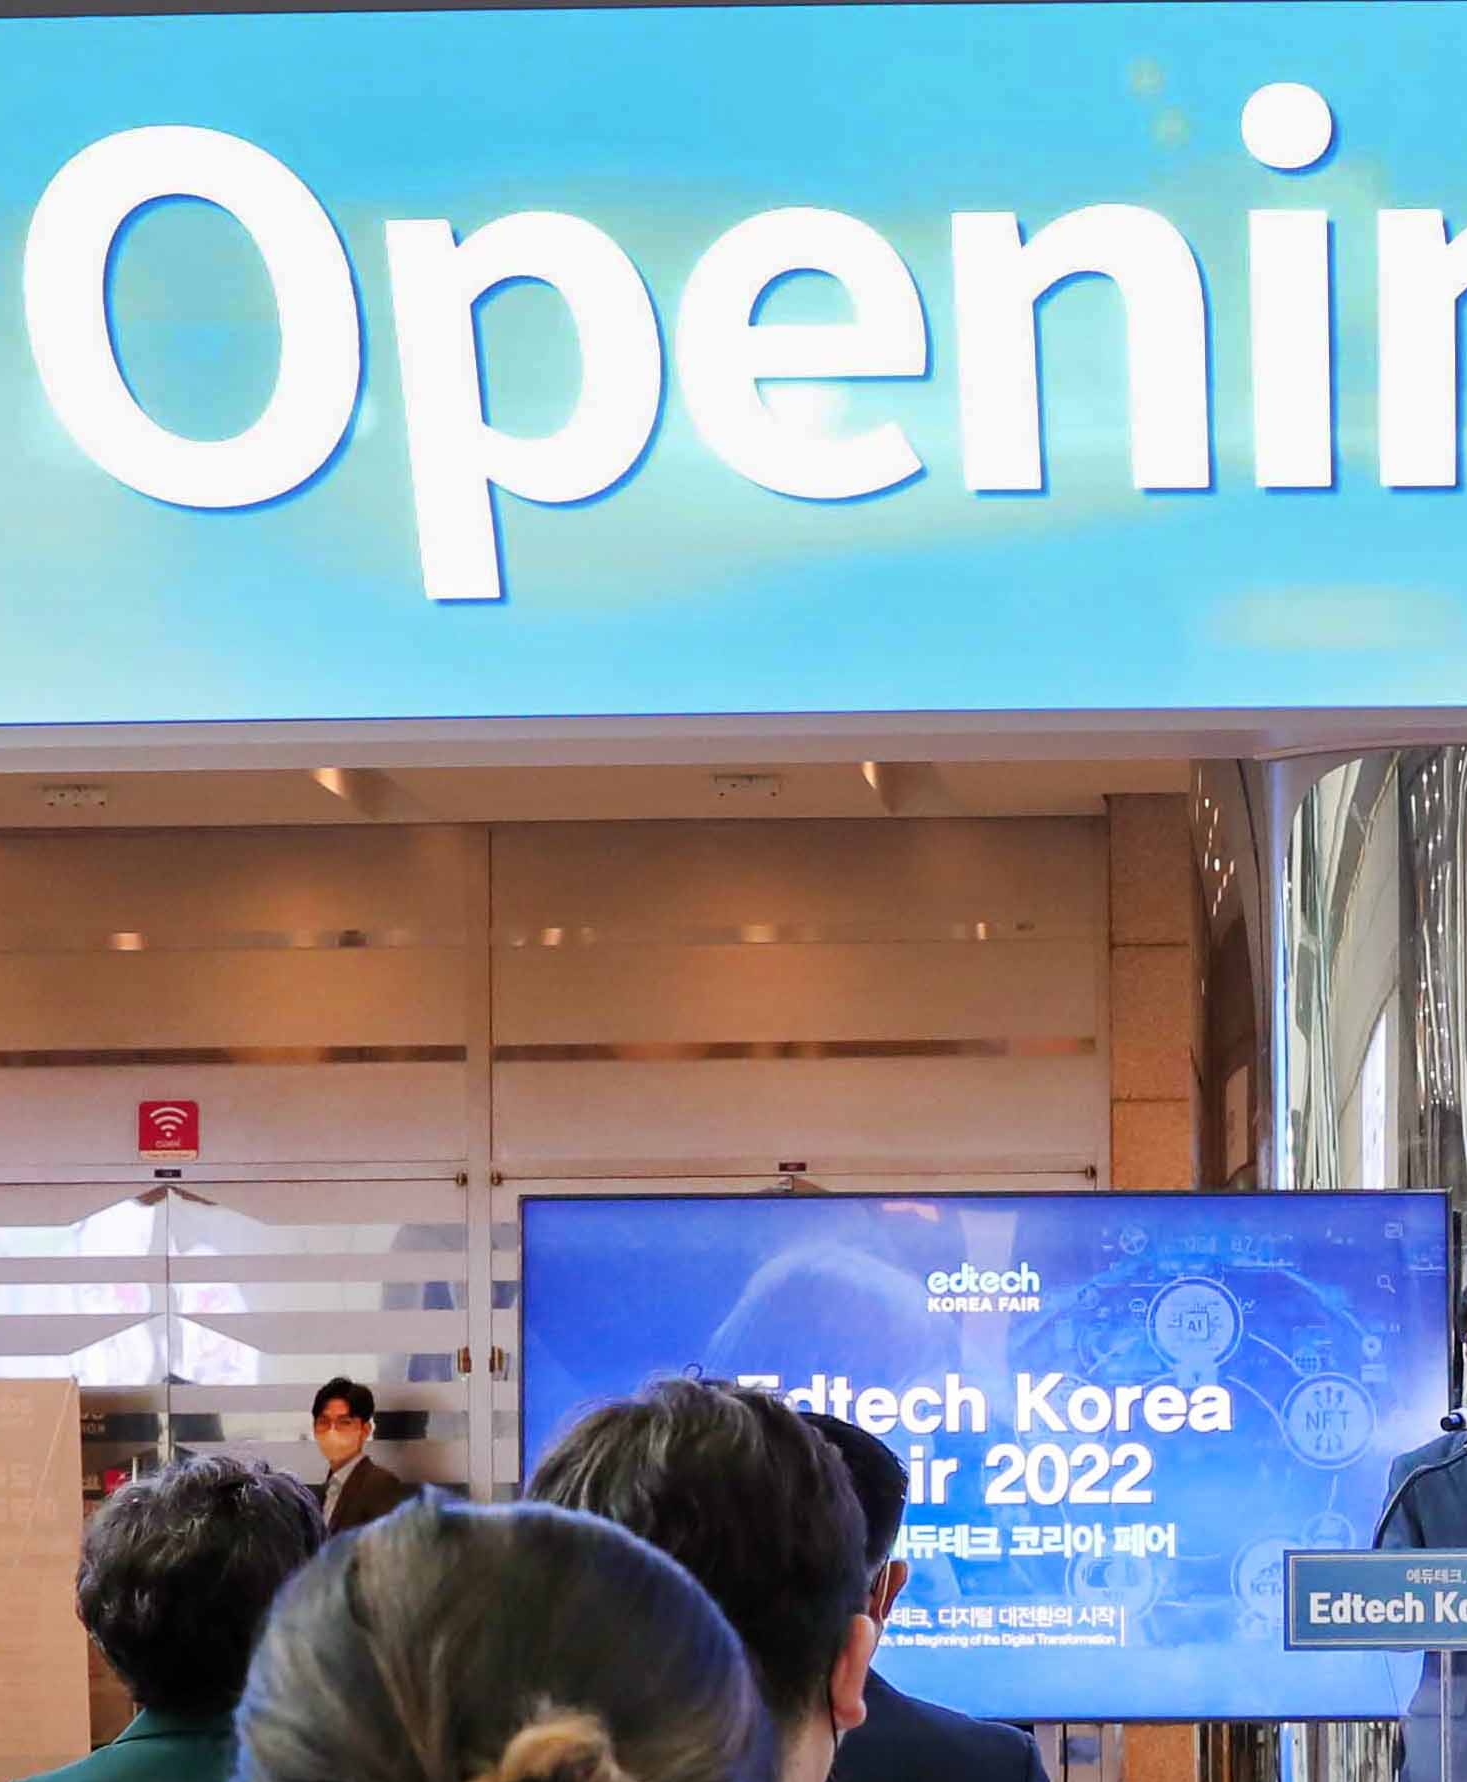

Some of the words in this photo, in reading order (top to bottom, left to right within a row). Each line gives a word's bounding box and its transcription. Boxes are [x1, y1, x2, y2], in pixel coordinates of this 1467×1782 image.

[927, 1262, 1040, 1293] edtech
[928, 1297, 992, 1312] KOREA
[999, 1297, 1040, 1312] FAIR
[737, 1373, 987, 1433] dtech
[1016, 1373, 1232, 1433] Korea
[1305, 1410, 1350, 1430] NFT
[909, 1446, 958, 1505] ir
[984, 1443, 1154, 1505] 2022
[1009, 1522, 1106, 1559] 코리아
[1113, 1522, 1176, 1559] 페어
[1405, 1568, 1467, 1585] 에듀테크,
[938, 1605, 994, 1629] 디지털
[1076, 1605, 1116, 1628] 시작
[1309, 1592, 1425, 1624] Edtech
